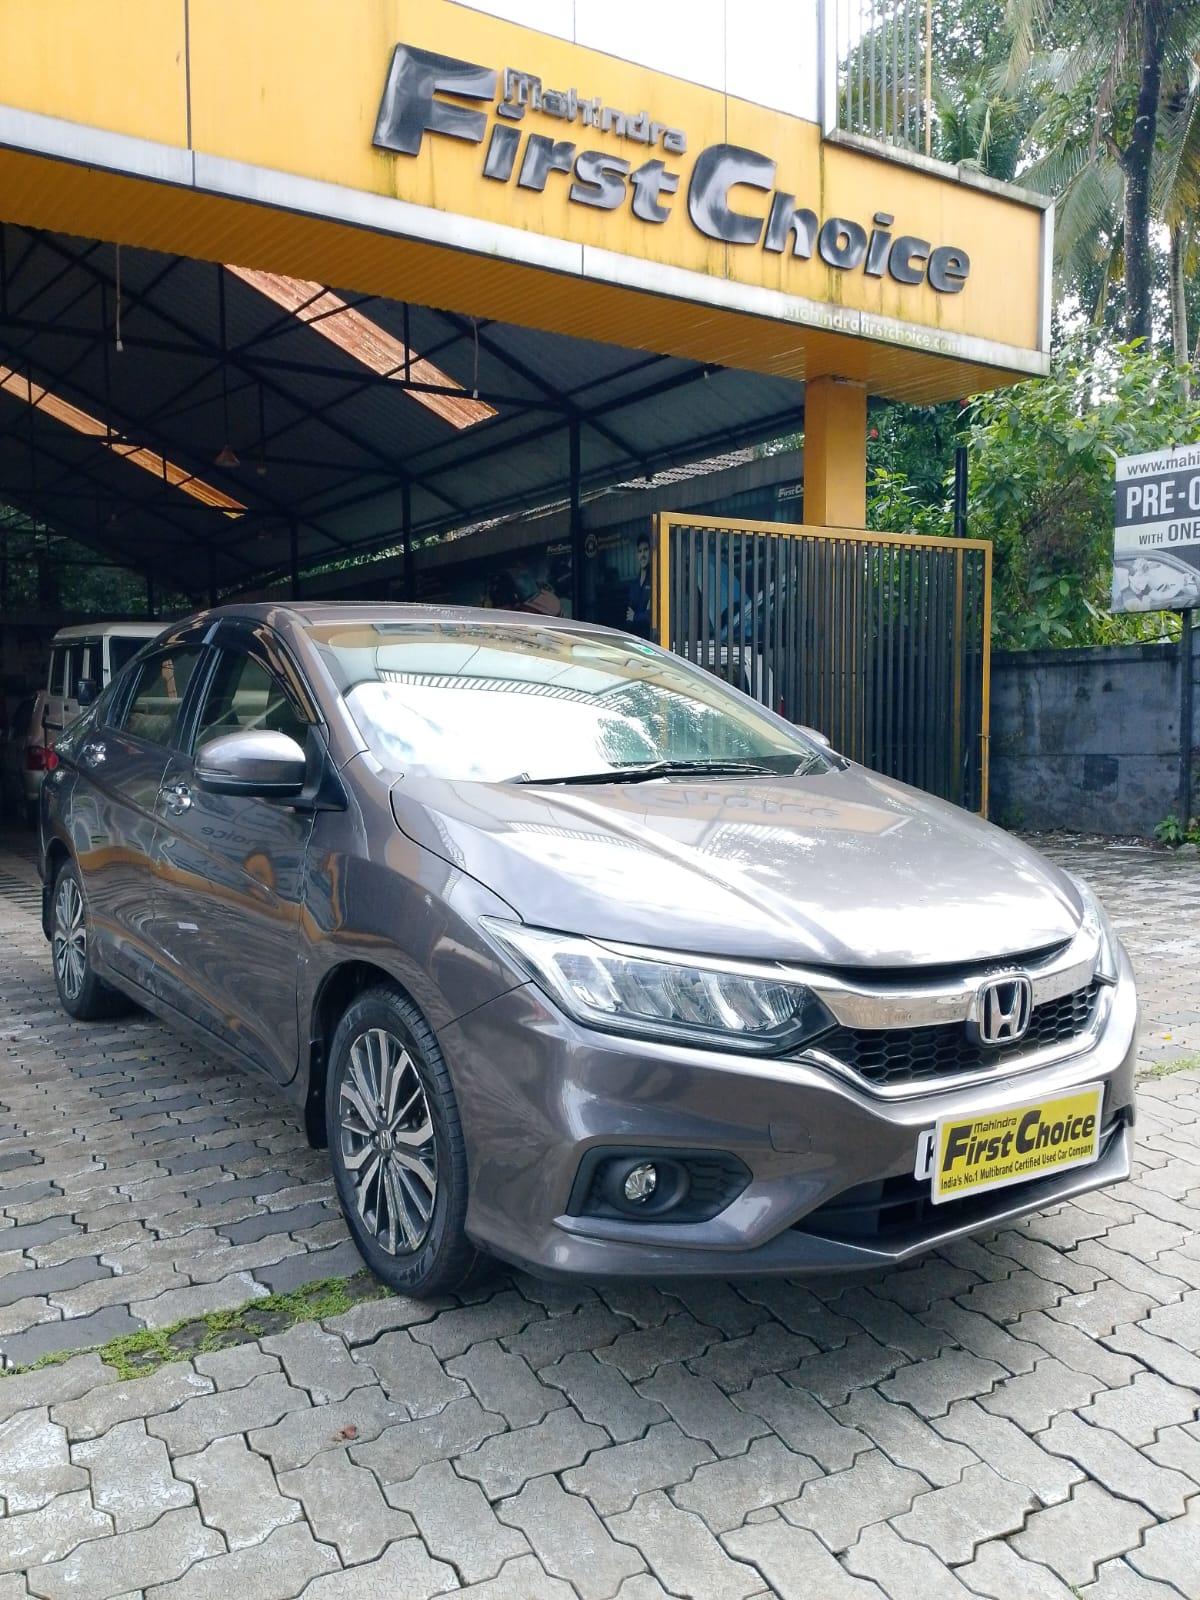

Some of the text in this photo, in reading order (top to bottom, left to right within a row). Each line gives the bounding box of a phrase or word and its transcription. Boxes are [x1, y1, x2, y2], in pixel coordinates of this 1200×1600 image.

[687, 143, 971, 293] Choice
[1139, 533, 1163, 545] WITH
[941, 1143, 1093, 1190] India's No.1 Multibrand Certified Used Car Company
